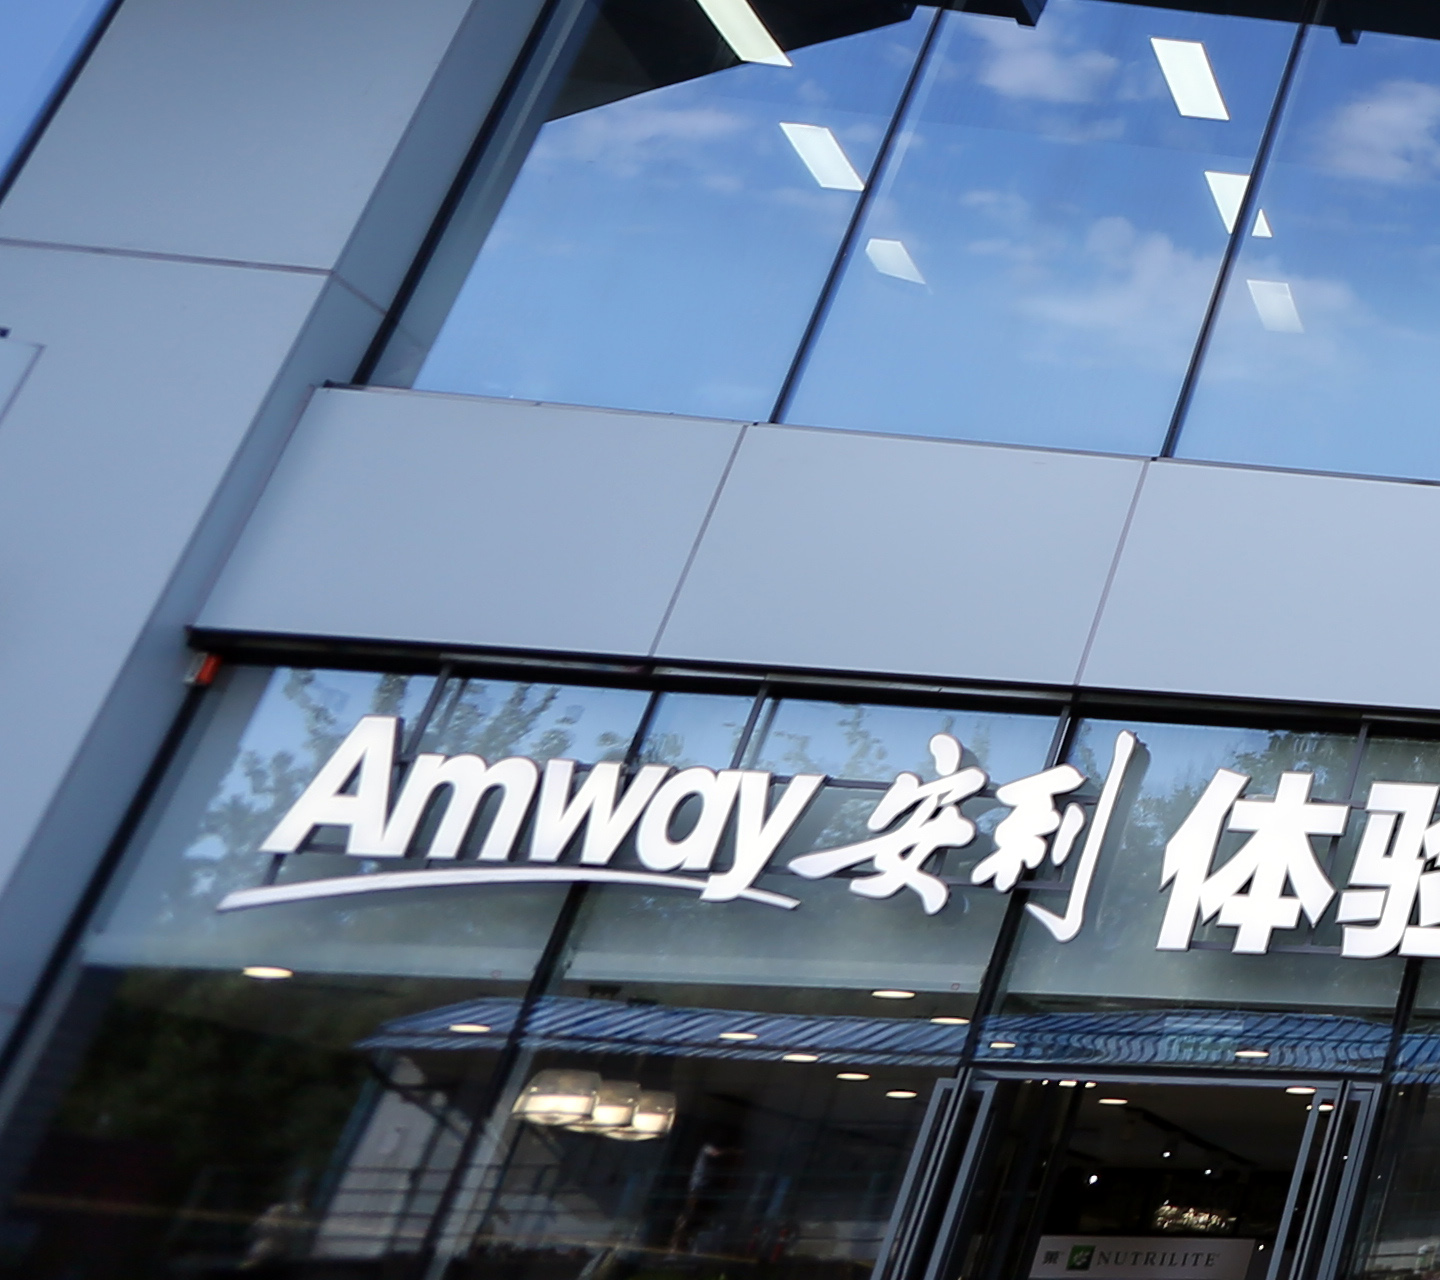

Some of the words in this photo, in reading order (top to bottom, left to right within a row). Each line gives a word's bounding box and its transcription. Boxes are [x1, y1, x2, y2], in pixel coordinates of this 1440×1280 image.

[258, 714, 825, 903] Amway
[788, 730, 1140, 943] 安利
[1096, 1251, 1217, 1268] NUTRILITE
